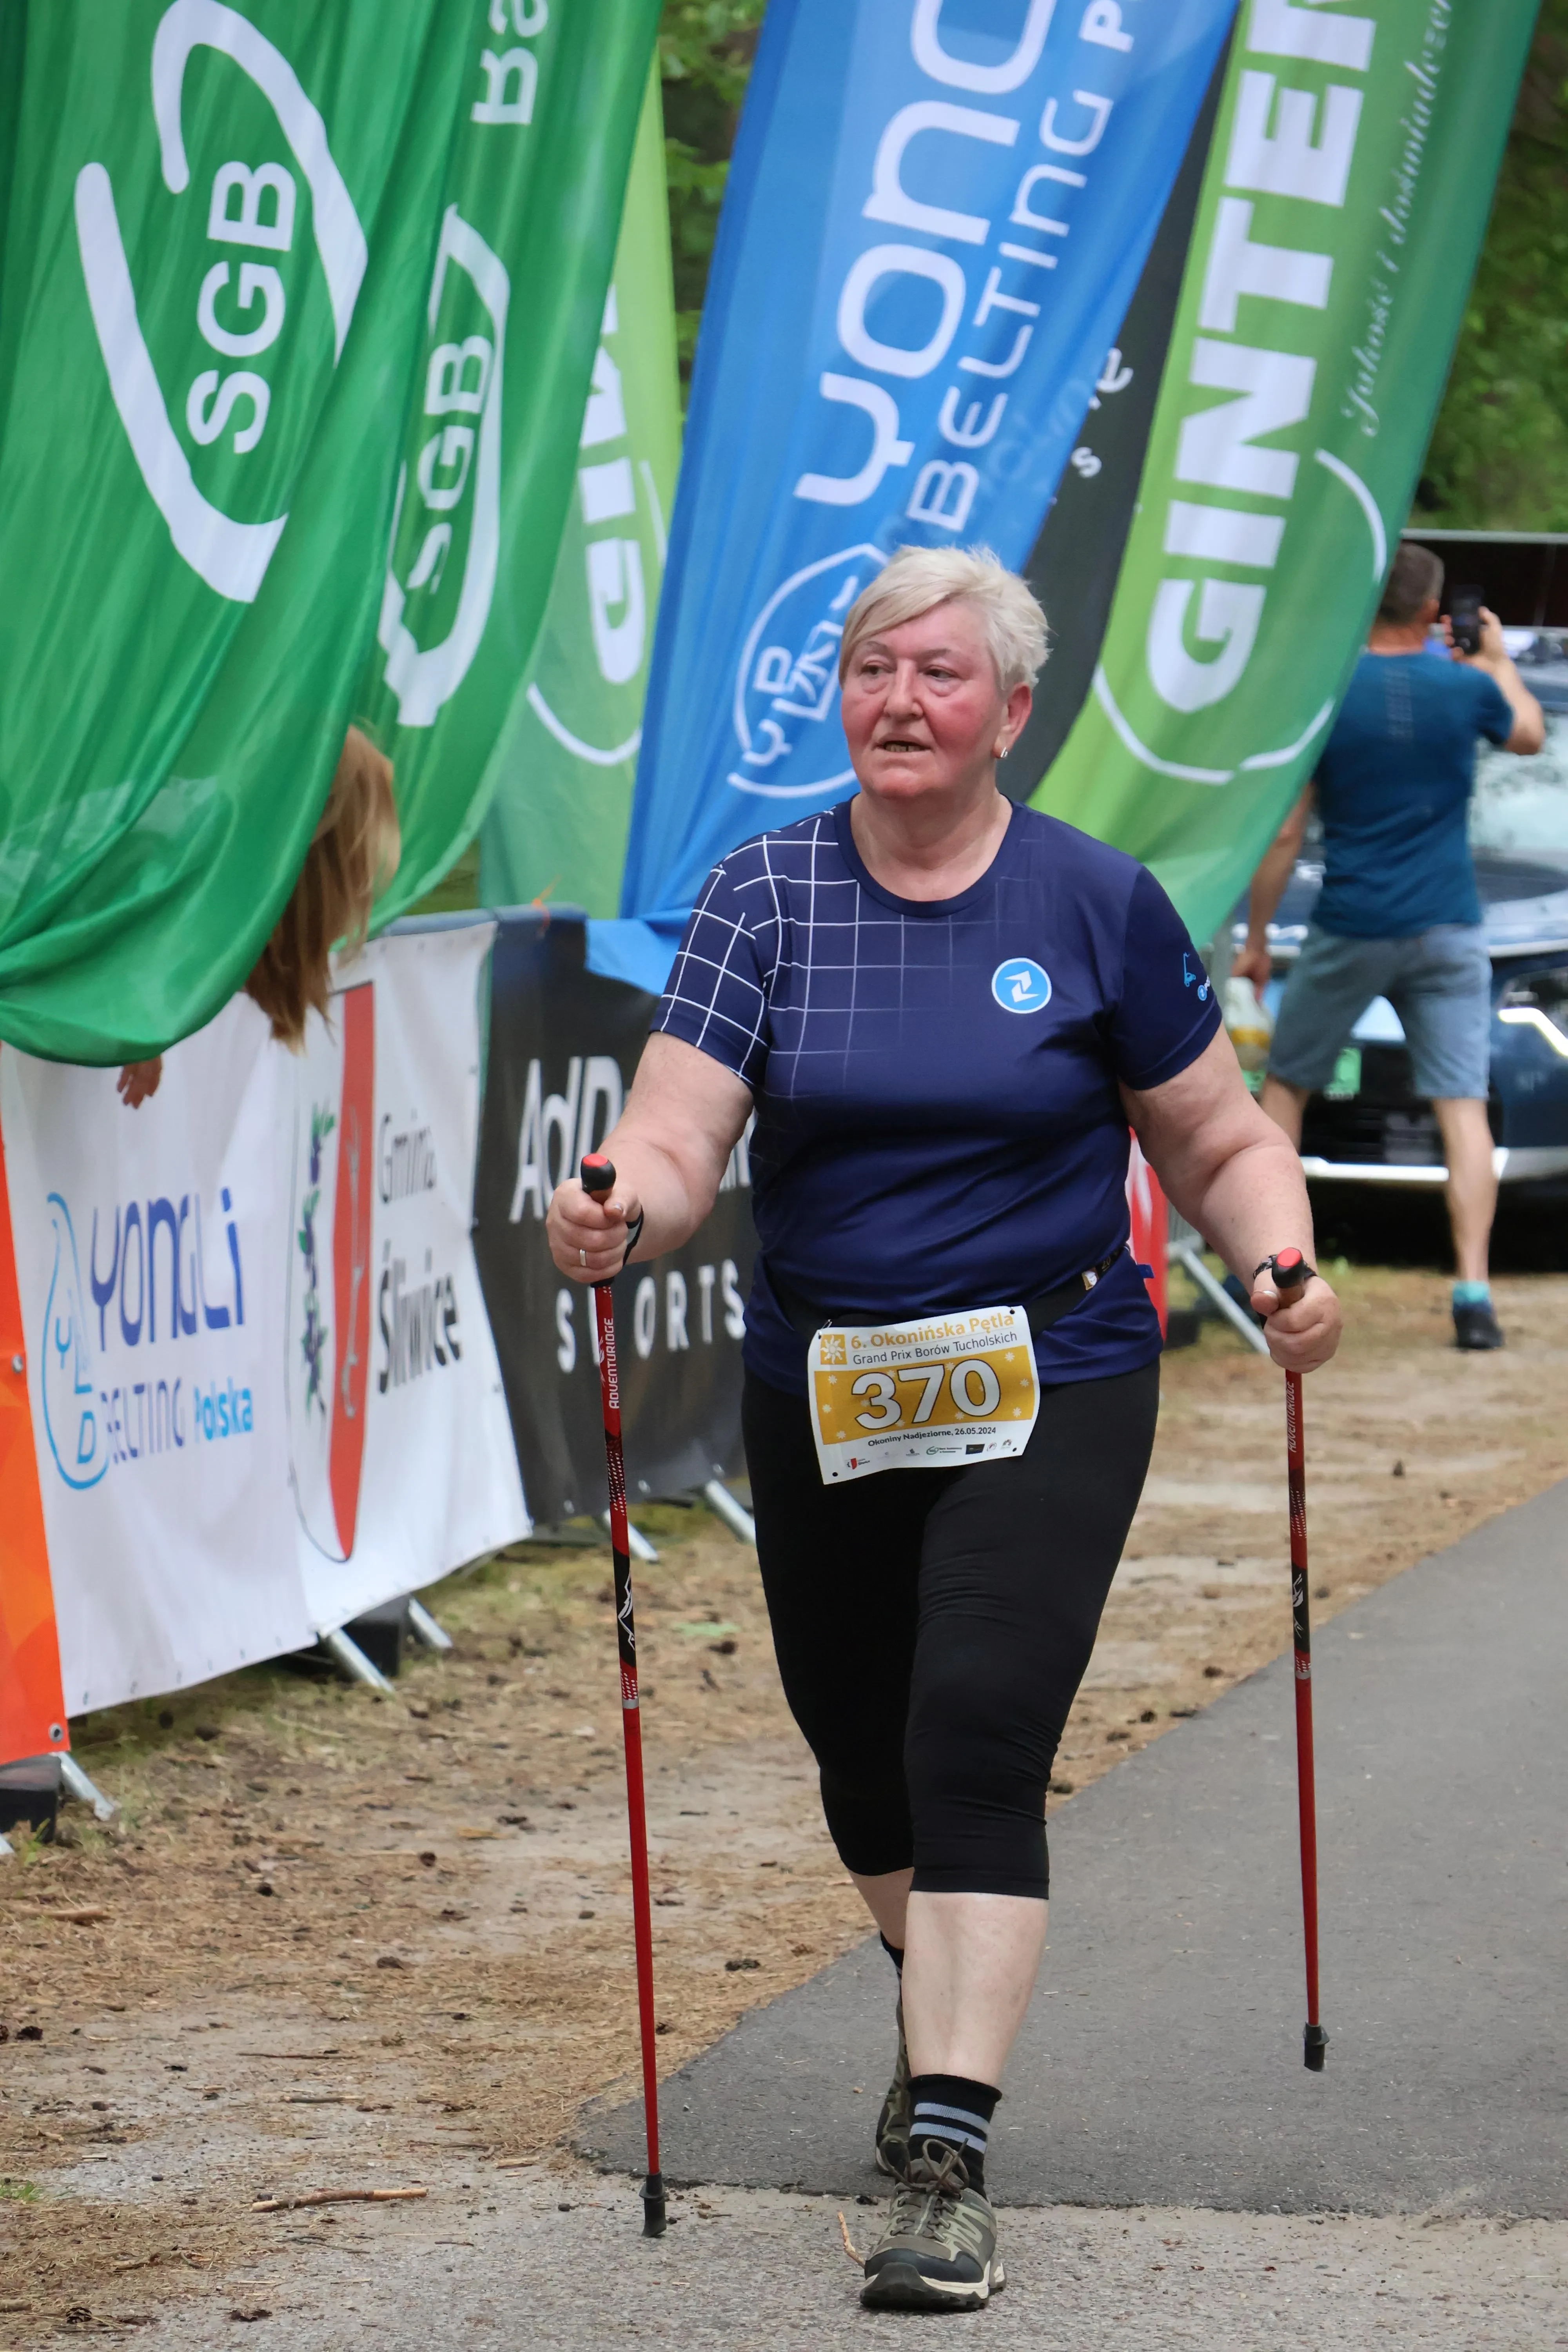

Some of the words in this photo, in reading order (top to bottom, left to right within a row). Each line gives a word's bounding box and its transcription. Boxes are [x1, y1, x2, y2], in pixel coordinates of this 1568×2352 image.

[186, 161, 296, 454] SGB
[407, 336, 494, 593] SGB
[604, 1318, 620, 1409] ADVENTURIDGE
[851, 1335, 867, 1349] 6.
[870, 1322, 965, 1347] Okonińska
[968, 1312, 1014, 1334] Pętla
[853, 1352, 887, 1365] Grand
[891, 1350, 912, 1361] Prix
[916, 1345, 950, 1358] Borów
[953, 1331, 1018, 1352] Tucholskich
[851, 1359, 1001, 1430] 370
[867, 1435, 902, 1446] Okoniny
[903, 1428, 954, 1440] Nadjeziorne,
[955, 1427, 996, 1436] 26.05.2024
